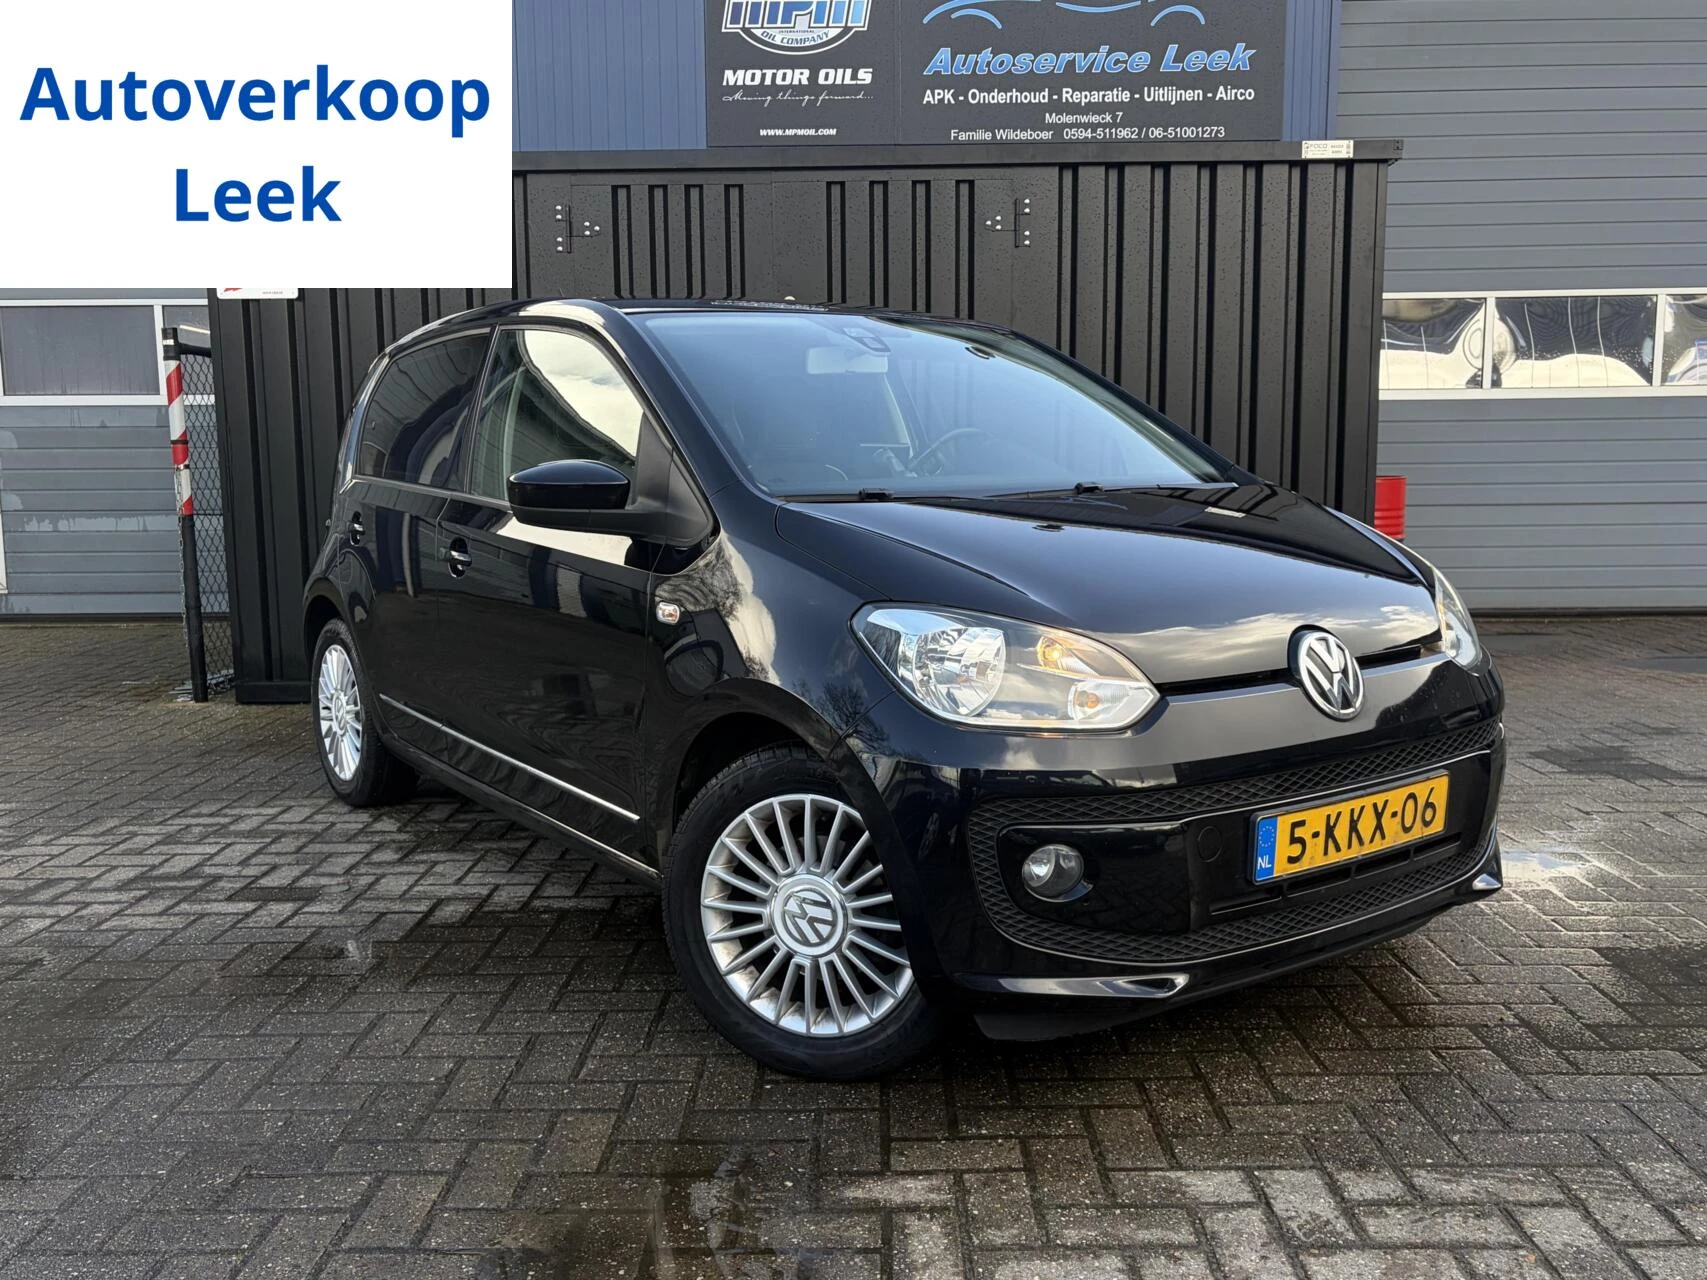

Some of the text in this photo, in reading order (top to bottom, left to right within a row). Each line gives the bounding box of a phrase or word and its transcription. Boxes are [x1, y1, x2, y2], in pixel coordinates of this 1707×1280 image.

[760, 30, 830, 45] OIL COMPANY
[923, 43, 1257, 75] Autoservice Leek
[722, 68, 873, 86] MOTOR OILS
[923, 89, 955, 105] APK
[968, 88, 1049, 104] Onderhoud
[1062, 87, 1131, 106] Reparatie
[1144, 86, 1203, 105] Uitlijnen
[1215, 85, 1255, 101] Airco
[1045, 112, 1123, 124] Molenwieck 7
[759, 128, 837, 136] WWW.MPMOIL.COM
[951, 129, 992, 140] Familie
[995, 129, 1054, 140] Wildeboer
[1063, 127, 1139, 140] 0594-511962
[1148, 126, 1226, 139] 06-51001273
[1286, 786, 1437, 865] 5-KKX-06
[1257, 855, 1272, 870] NL
